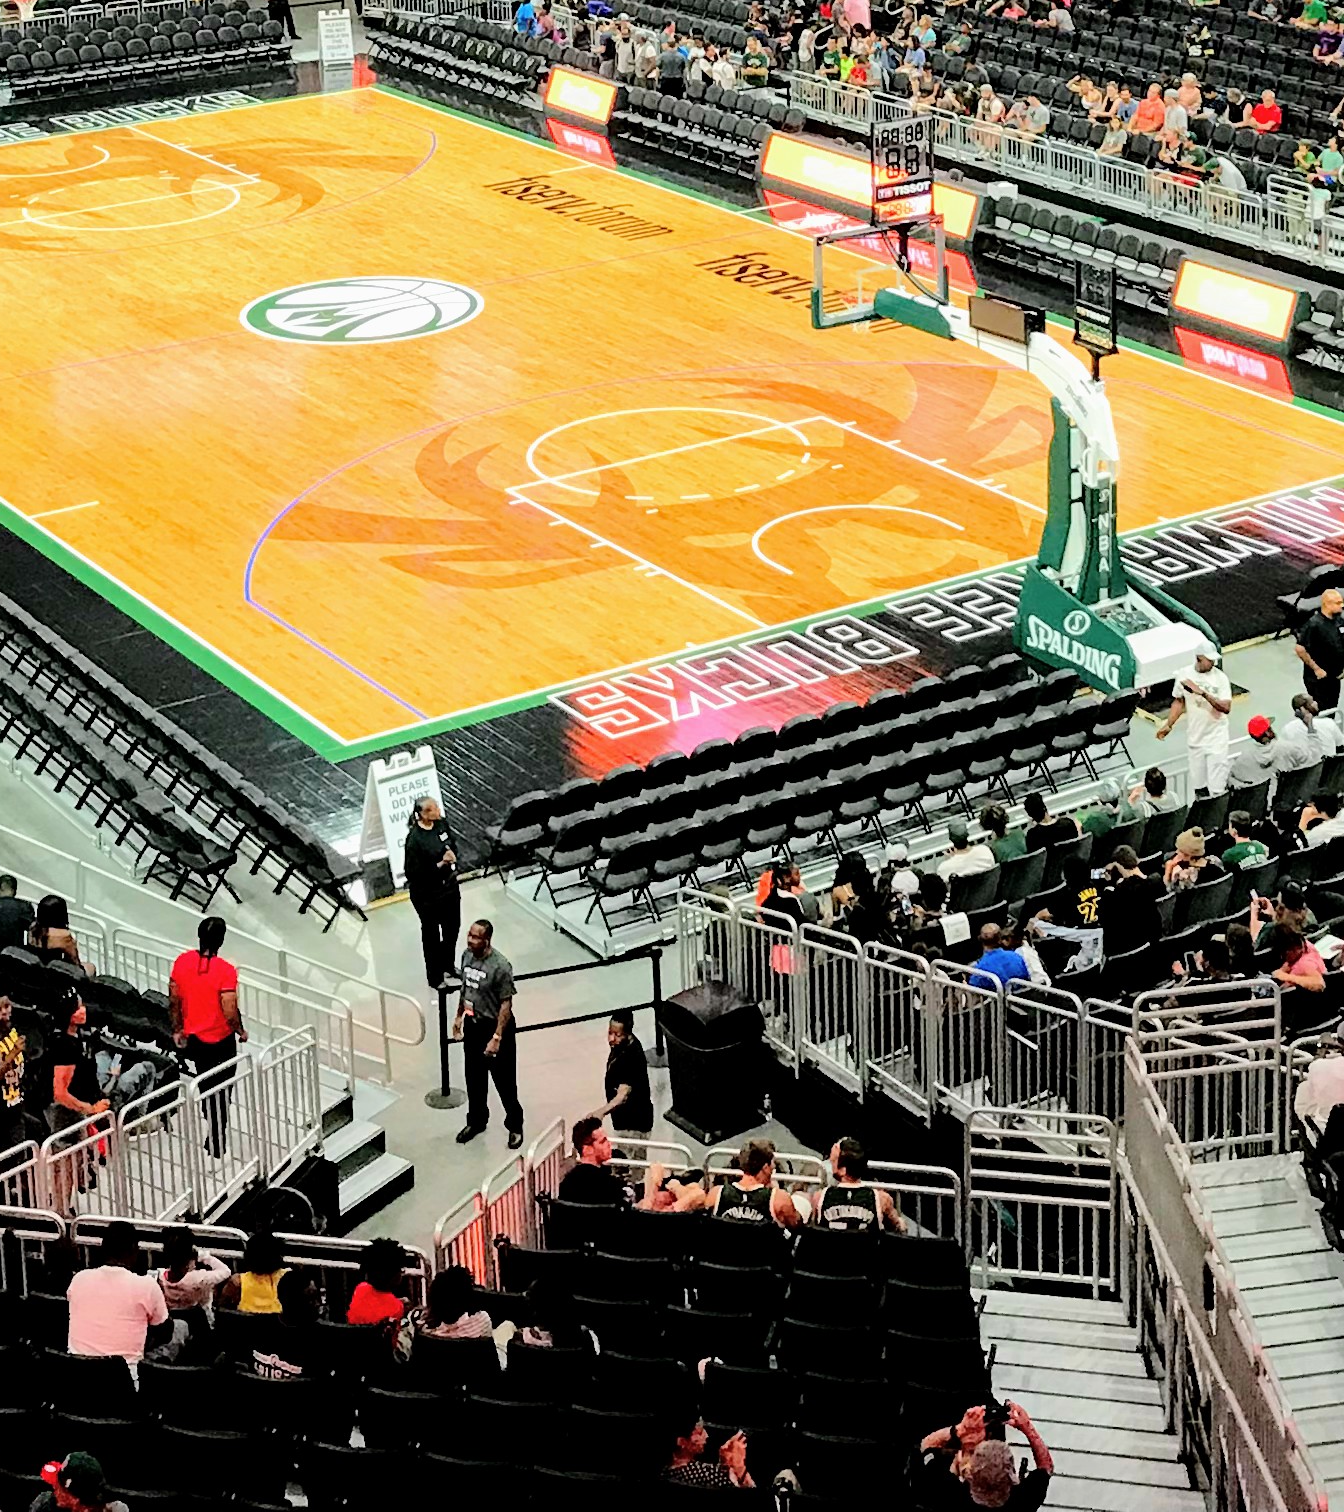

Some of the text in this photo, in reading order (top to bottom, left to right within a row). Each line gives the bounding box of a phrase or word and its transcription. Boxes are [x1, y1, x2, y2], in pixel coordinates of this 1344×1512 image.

[49, 90, 258, 133] BUCKS
[894, 181, 931, 196] TISSOT
[1026, 614, 1122, 690] SPALDING
[548, 614, 920, 739] BUCKS
[388, 777, 430, 797] PLEASE
[392, 798, 407, 809] DO
